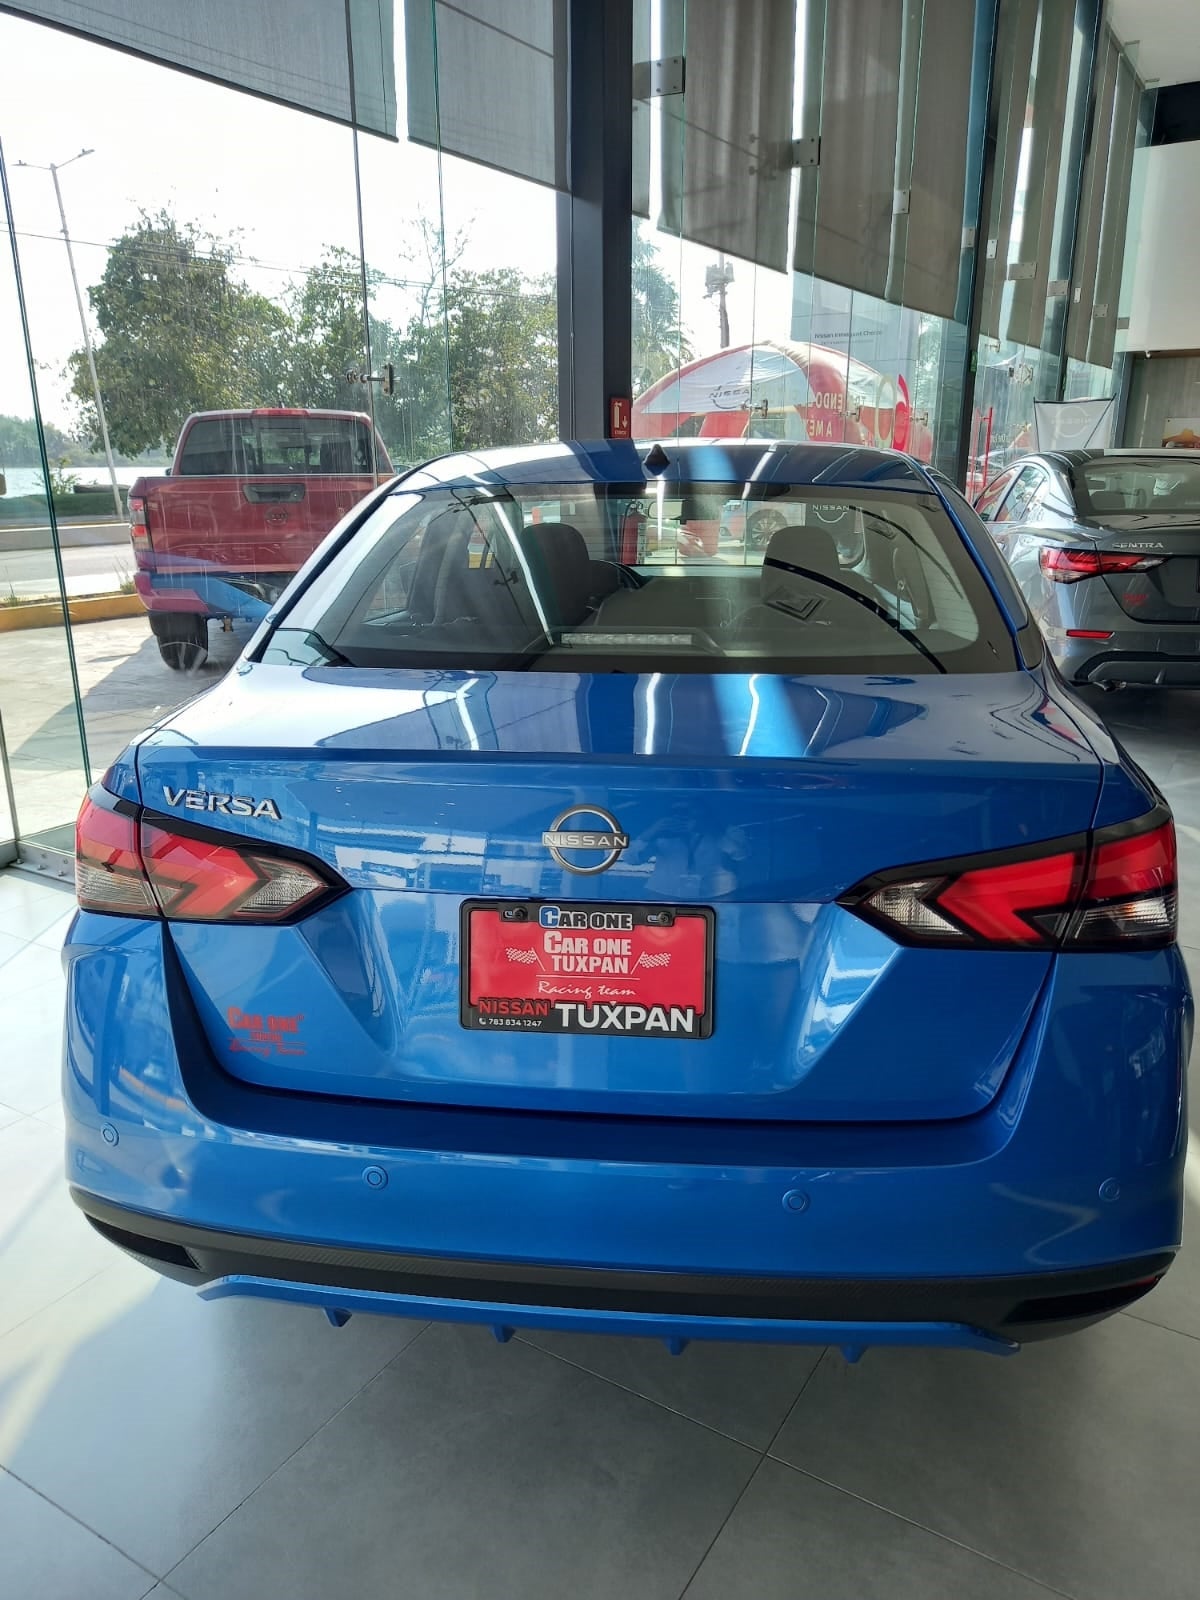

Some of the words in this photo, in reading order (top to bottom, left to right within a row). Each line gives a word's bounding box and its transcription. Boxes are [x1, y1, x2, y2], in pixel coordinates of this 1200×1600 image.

[163, 785, 282, 820] VERSA
[543, 834, 628, 847] NISSAN
[539, 906, 588, 929] CAR
[590, 912, 633, 931] ONE
[543, 930, 589, 954] CAR
[593, 938, 632, 955] ONE
[551, 955, 629, 974] TUXPAN
[538, 980, 593, 999] Racing
[598, 984, 636, 996] team
[480, 1000, 548, 1016] NISSAN
[554, 1003, 693, 1033] TUXPAN
[488, 1018, 504, 1026] 783
[523, 1019, 542, 1027] 1247
